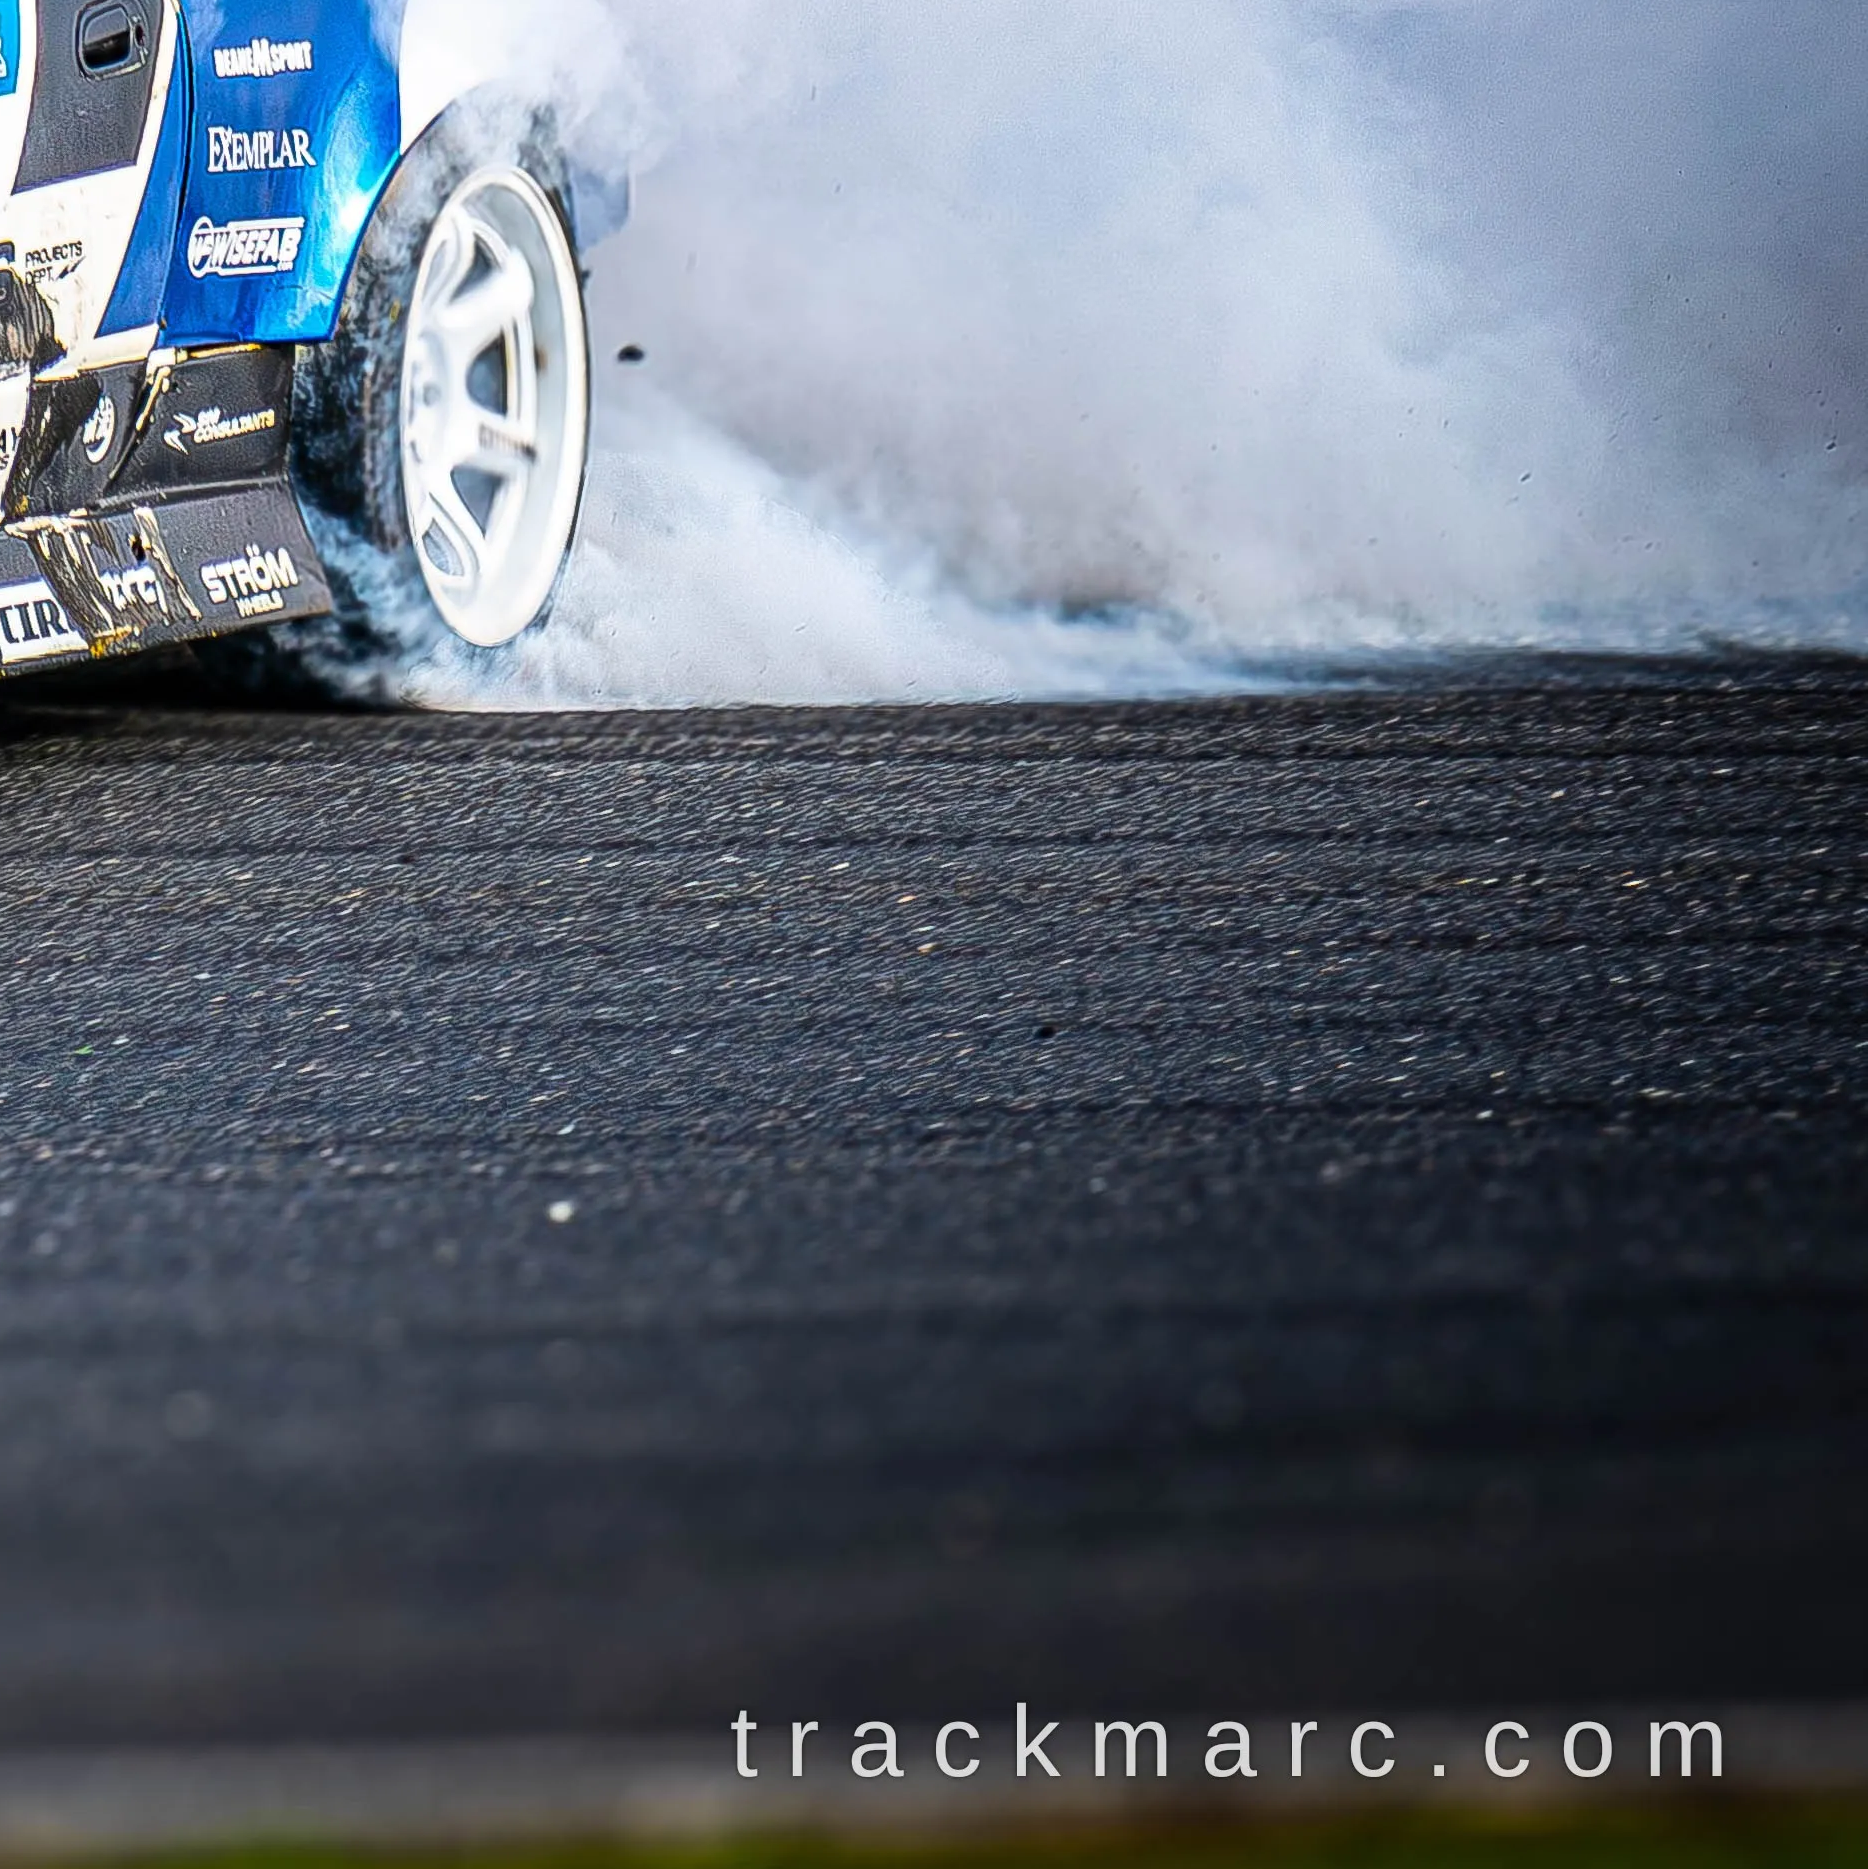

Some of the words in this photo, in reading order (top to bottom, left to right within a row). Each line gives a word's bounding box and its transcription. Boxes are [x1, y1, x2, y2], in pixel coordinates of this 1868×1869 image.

[207, 126, 316, 173] EXEMPLAR
[25, 240, 83, 268] PROJECTS
[200, 544, 298, 604] STRÖM
